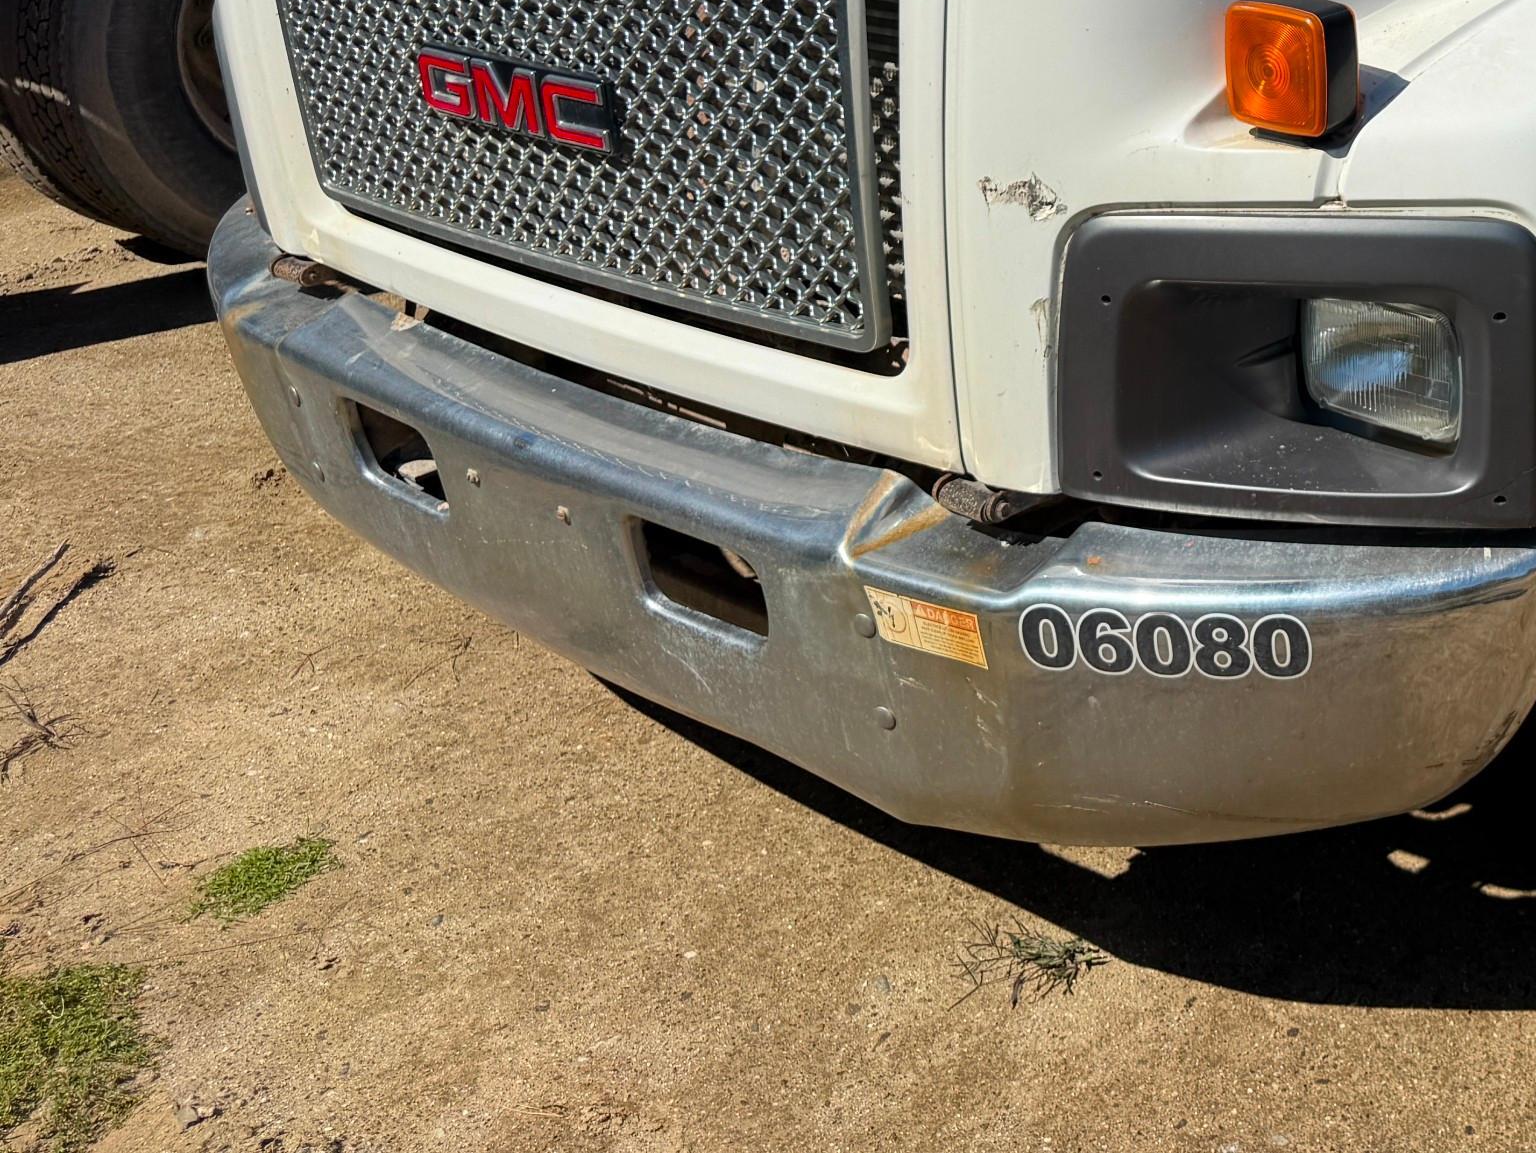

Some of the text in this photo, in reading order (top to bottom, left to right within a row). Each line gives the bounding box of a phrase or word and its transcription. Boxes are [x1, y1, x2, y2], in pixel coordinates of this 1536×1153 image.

[417, 47, 613, 153] GMC
[926, 608, 976, 631] DAGER
[1018, 603, 1312, 680] 06080
